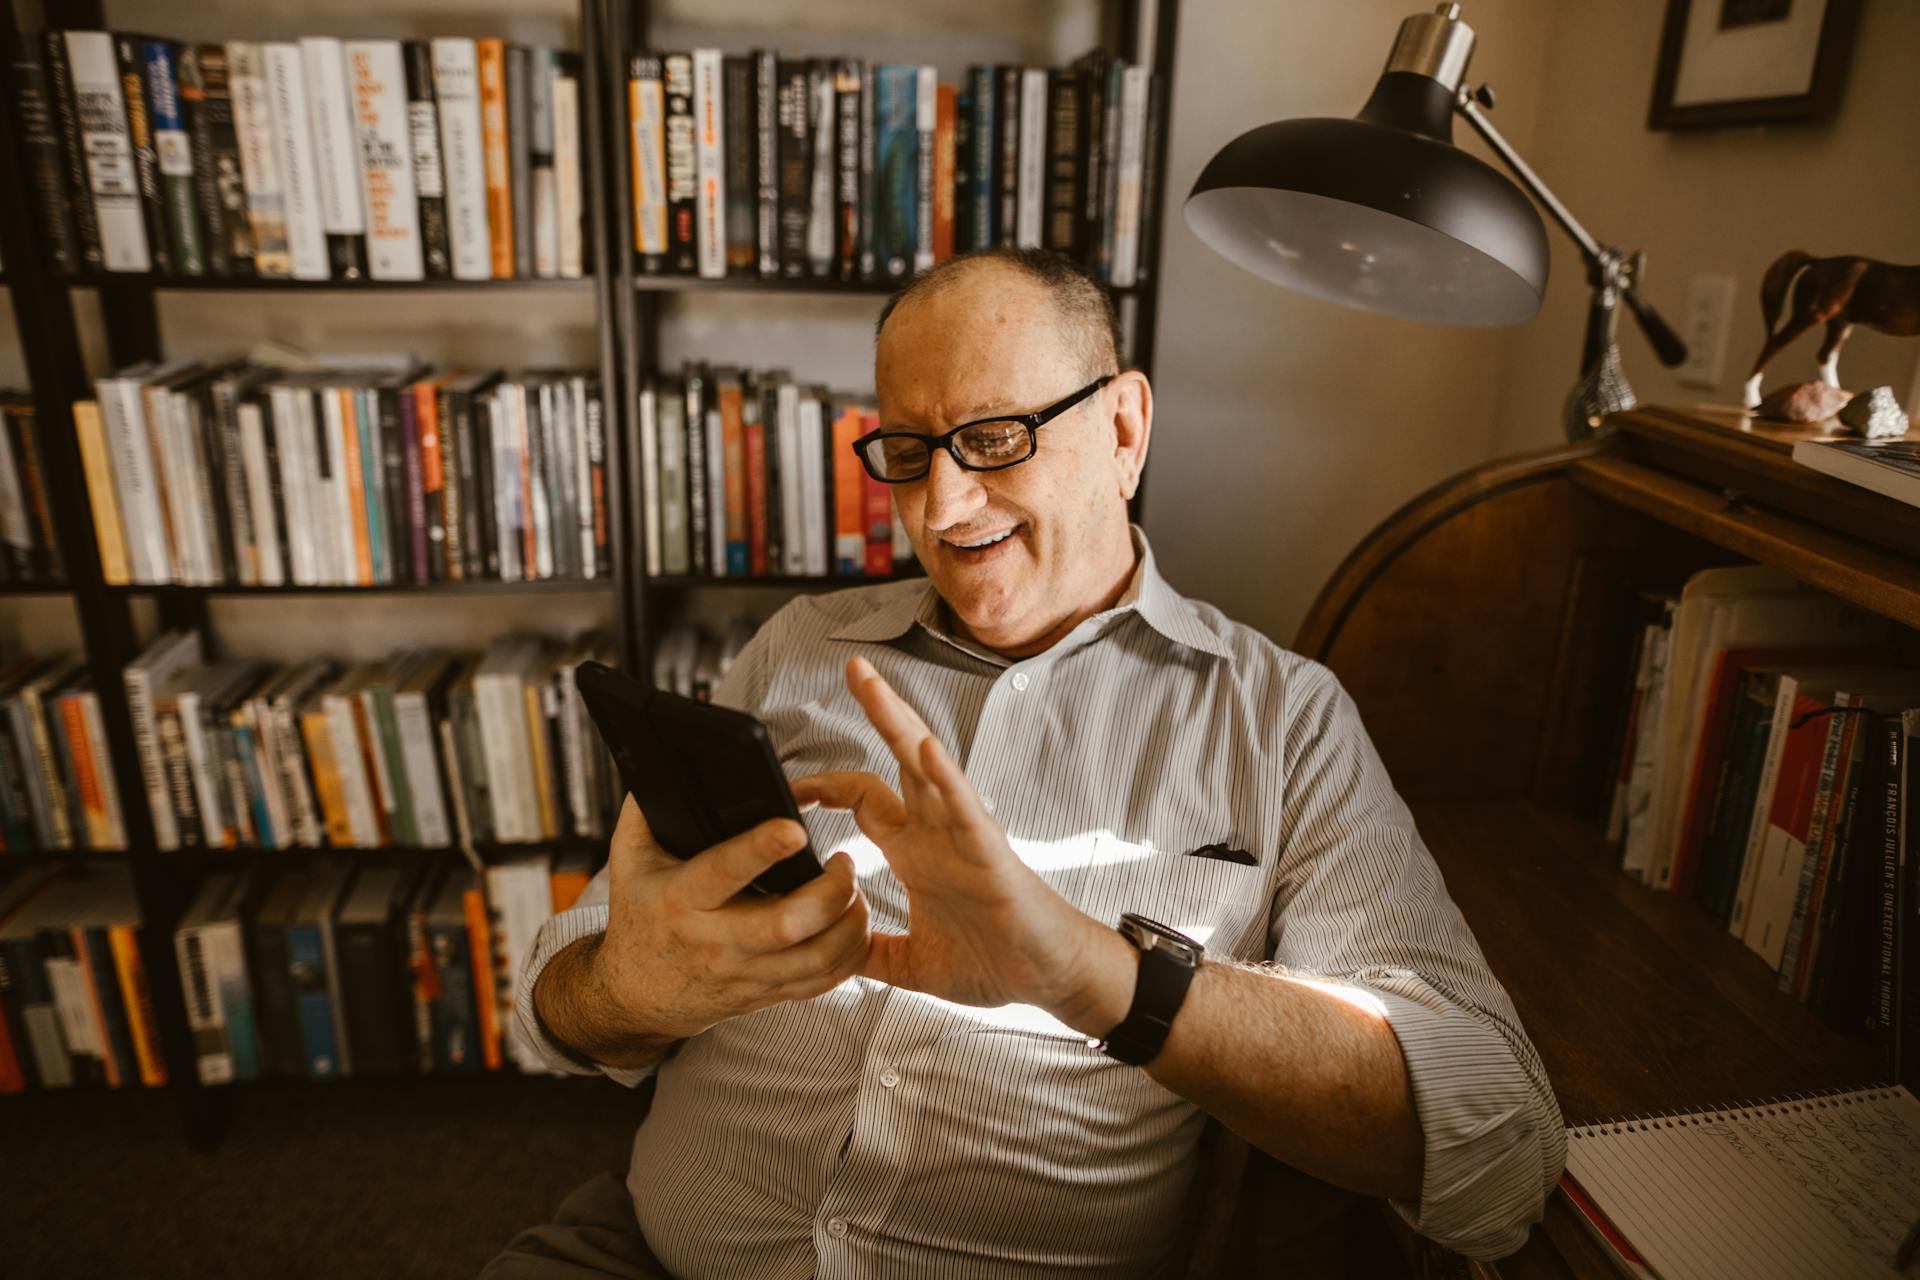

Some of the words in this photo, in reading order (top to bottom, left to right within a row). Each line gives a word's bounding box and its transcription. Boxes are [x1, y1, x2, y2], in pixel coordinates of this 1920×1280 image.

[1885, 783, 1898, 835] FRANÇOIS
[1883, 838, 1896, 889] JULLIEN'S
[1880, 892, 1895, 974] UNEXCEPTIONAL
[1879, 975, 1892, 1026] THOUGHT
